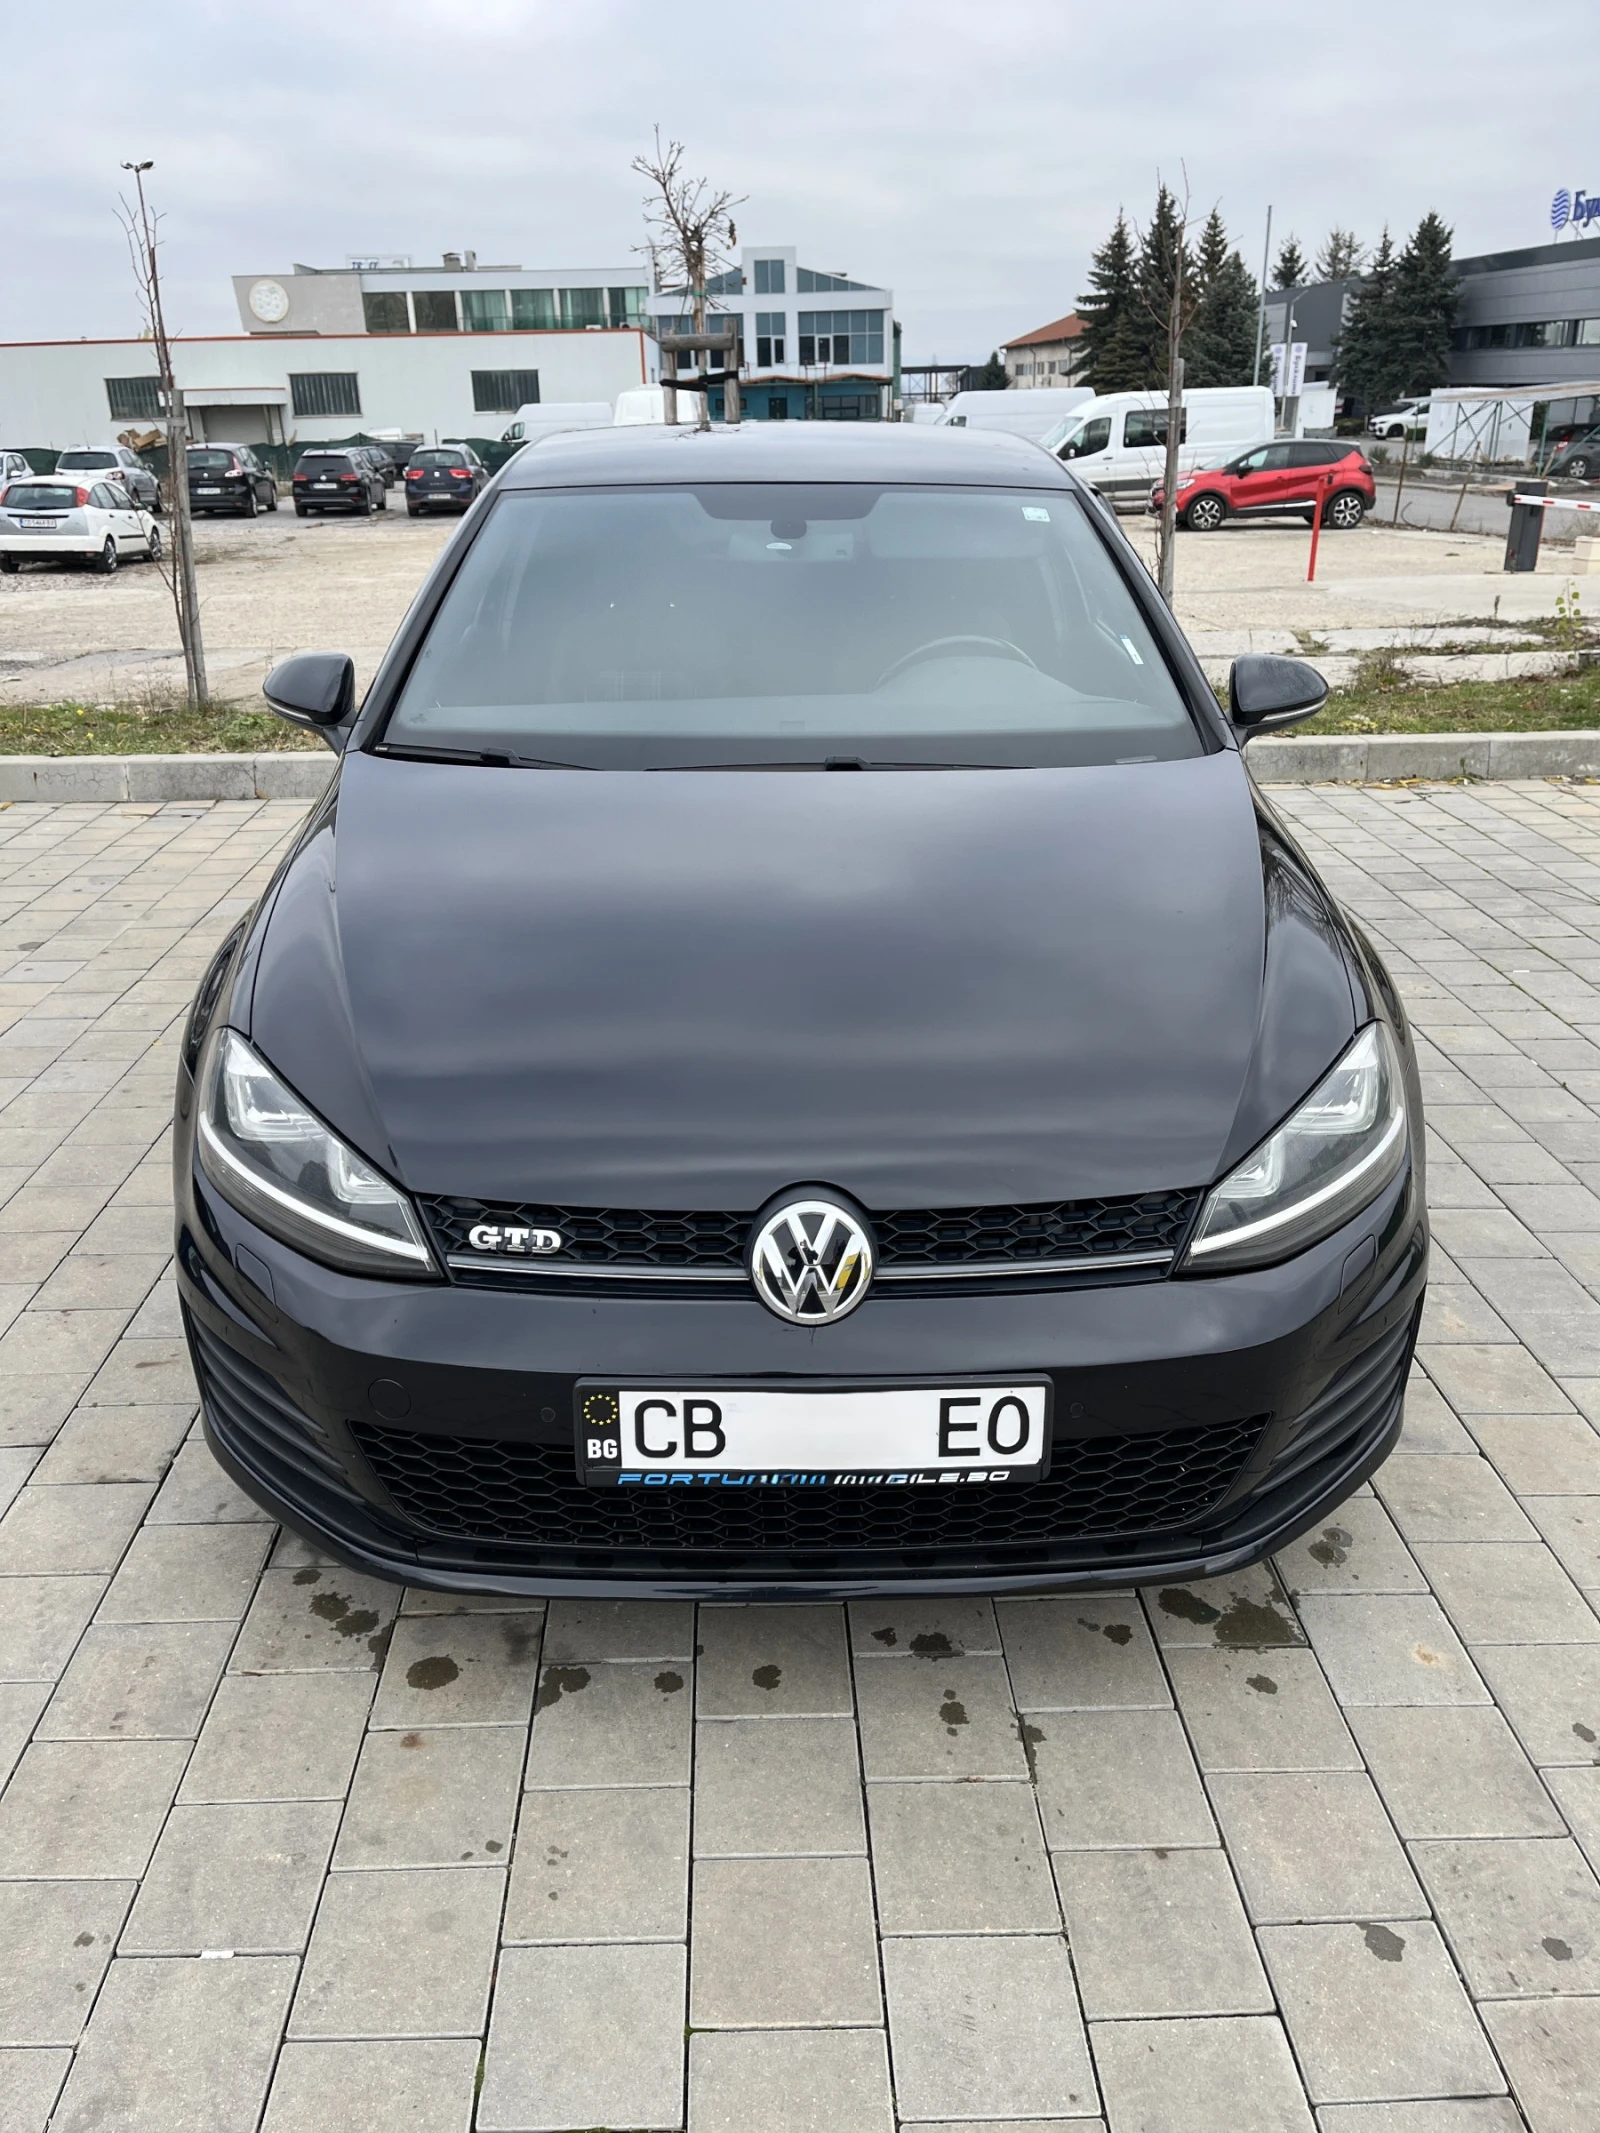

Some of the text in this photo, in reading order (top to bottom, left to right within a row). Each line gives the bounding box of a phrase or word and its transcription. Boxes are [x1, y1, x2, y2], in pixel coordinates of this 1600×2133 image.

[469, 1225, 561, 1254] GTD
[634, 1399, 726, 1459] CB
[587, 1438, 618, 1459] BG
